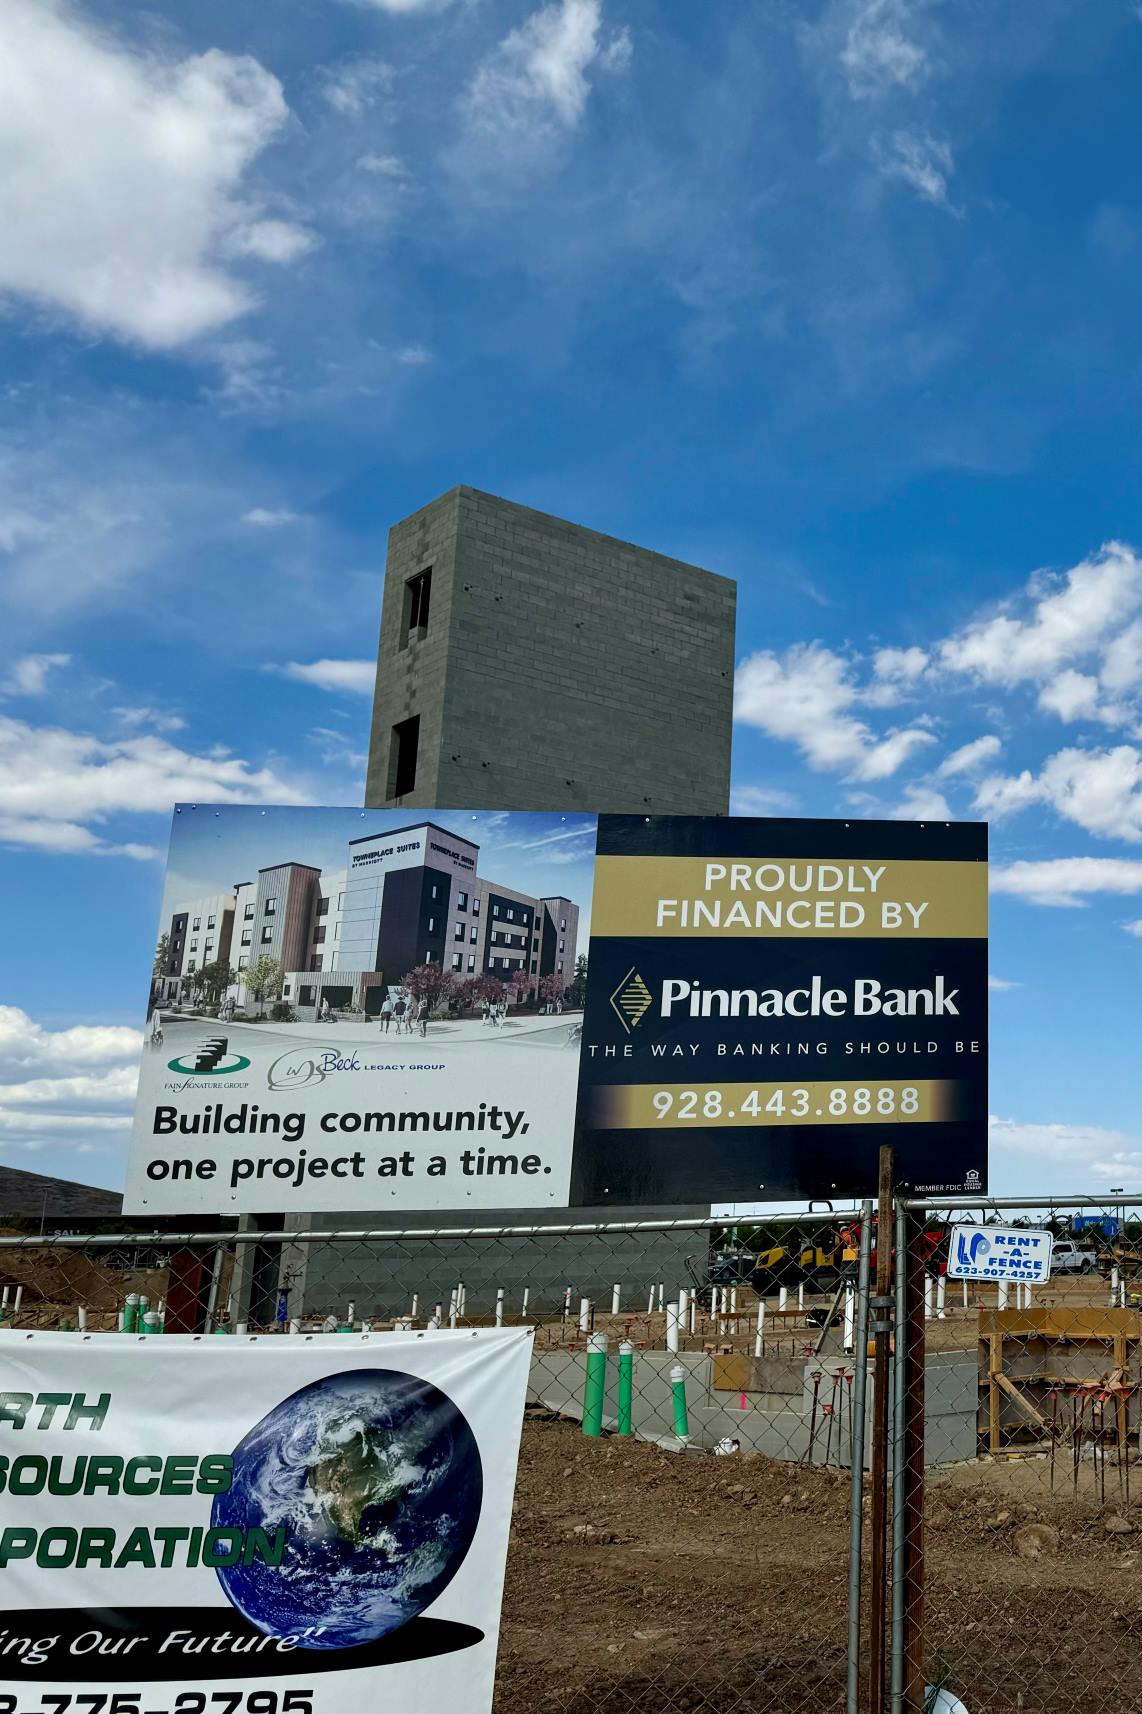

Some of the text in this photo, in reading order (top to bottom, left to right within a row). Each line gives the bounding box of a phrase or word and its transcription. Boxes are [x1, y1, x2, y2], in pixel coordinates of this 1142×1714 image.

[397, 842, 420, 853] SUITES
[704, 863, 887, 893] PROUDLY
[655, 899, 929, 929] FINANCED BY
[660, 975, 960, 1017] Pinnacle Bank
[321, 1050, 361, 1072] Beck
[588, 1041, 980, 1058] THE WAY BANKING SHOULD BE
[652, 1087, 919, 1120] 928.443.8888
[152, 1102, 530, 1142] Building community,
[146, 1147, 551, 1187] one project at a time.
[995, 1235, 1040, 1247] RENT
[1003, 1248, 1029, 1257] -A-
[955, 1266, 1041, 1279] 623-907-4257
[988, 1257, 1042, 1269] FENCE
[0, 1392, 111, 1430] RTH
[0, 1526, 286, 1568] PORATION
[69, 1630, 149, 1655] Our
